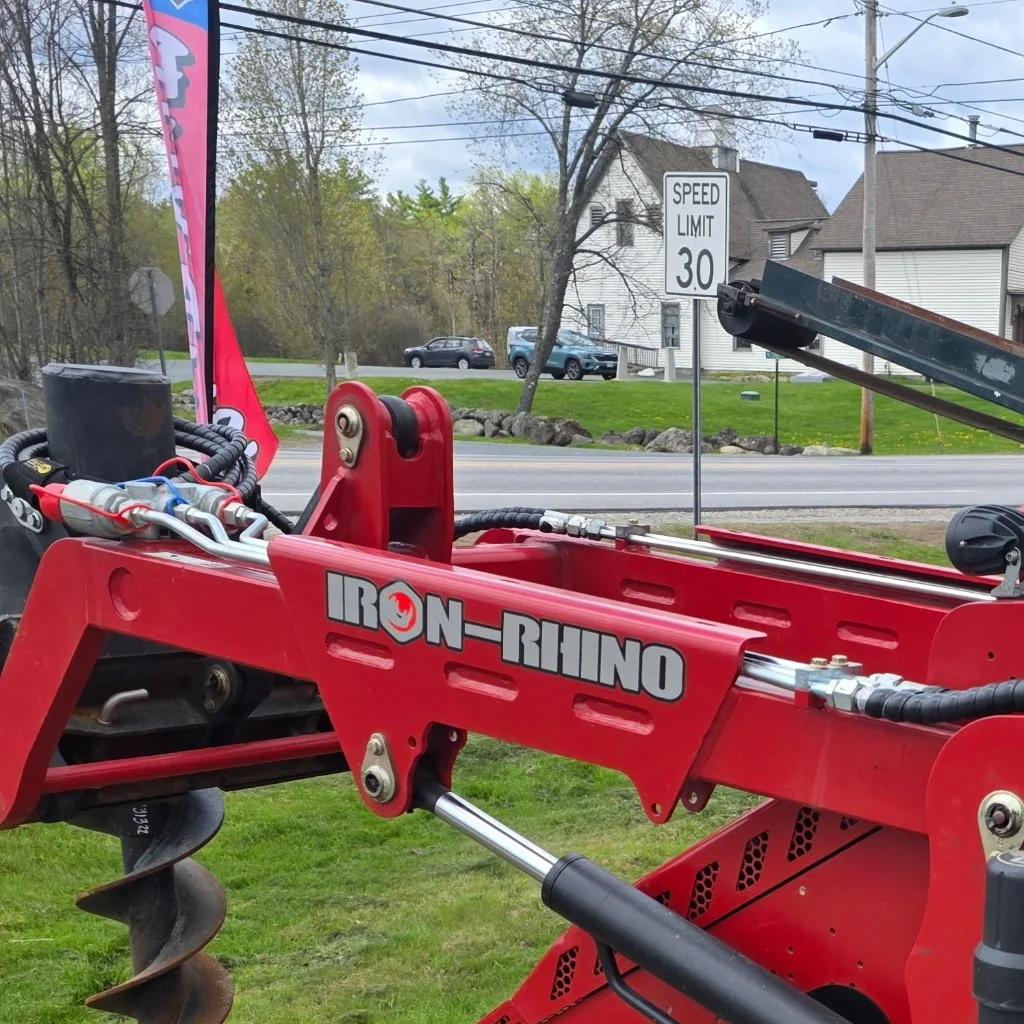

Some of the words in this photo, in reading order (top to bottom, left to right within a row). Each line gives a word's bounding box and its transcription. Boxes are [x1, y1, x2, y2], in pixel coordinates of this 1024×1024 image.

[673, 182, 720, 205] SPEED
[677, 214, 714, 237] LIMIT
[676, 246, 714, 290] 30
